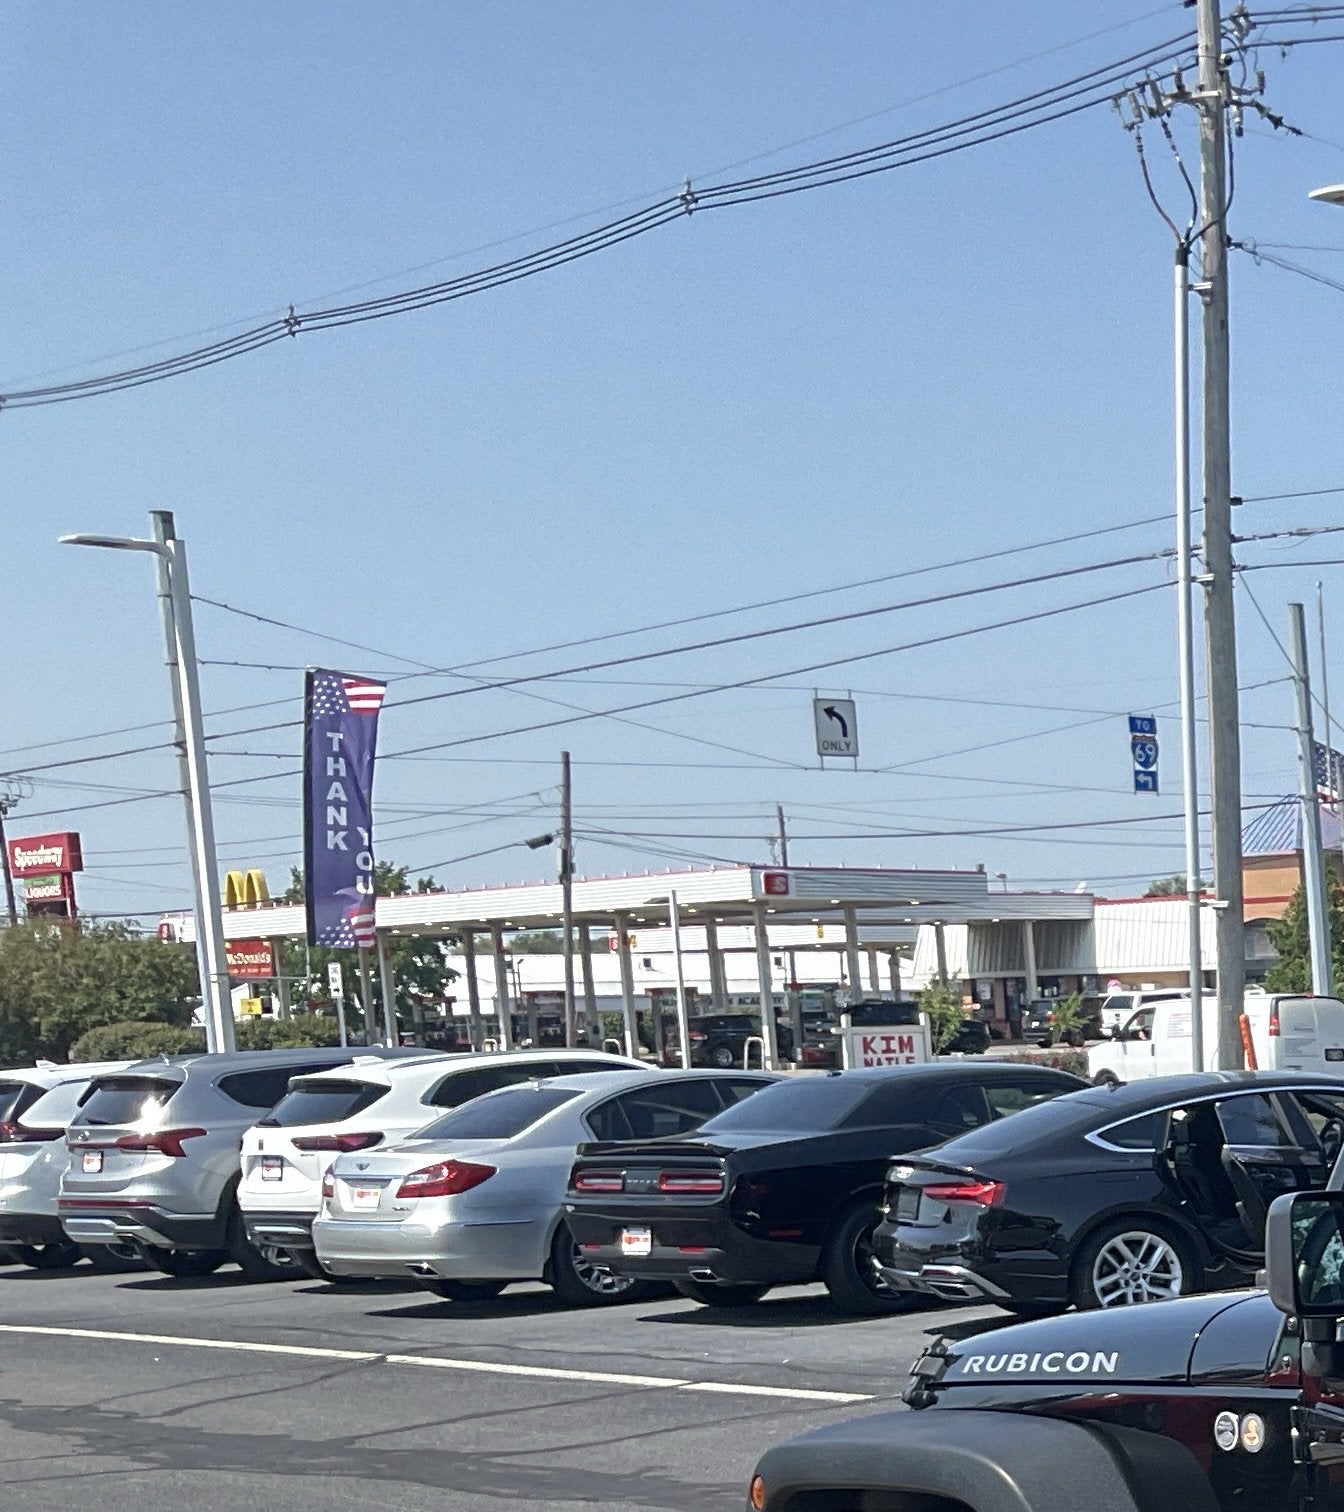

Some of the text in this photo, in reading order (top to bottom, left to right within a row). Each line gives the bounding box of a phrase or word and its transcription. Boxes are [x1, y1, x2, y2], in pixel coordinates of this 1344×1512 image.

[1135, 719, 1150, 731] TO
[822, 740, 851, 752] ONLY
[1134, 743, 1157, 763] 69
[326, 731, 374, 895] THANK YOU
[14, 844, 63, 872] Speedway
[862, 1034, 914, 1055] KIM
[962, 1351, 1119, 1373] RUBICON
